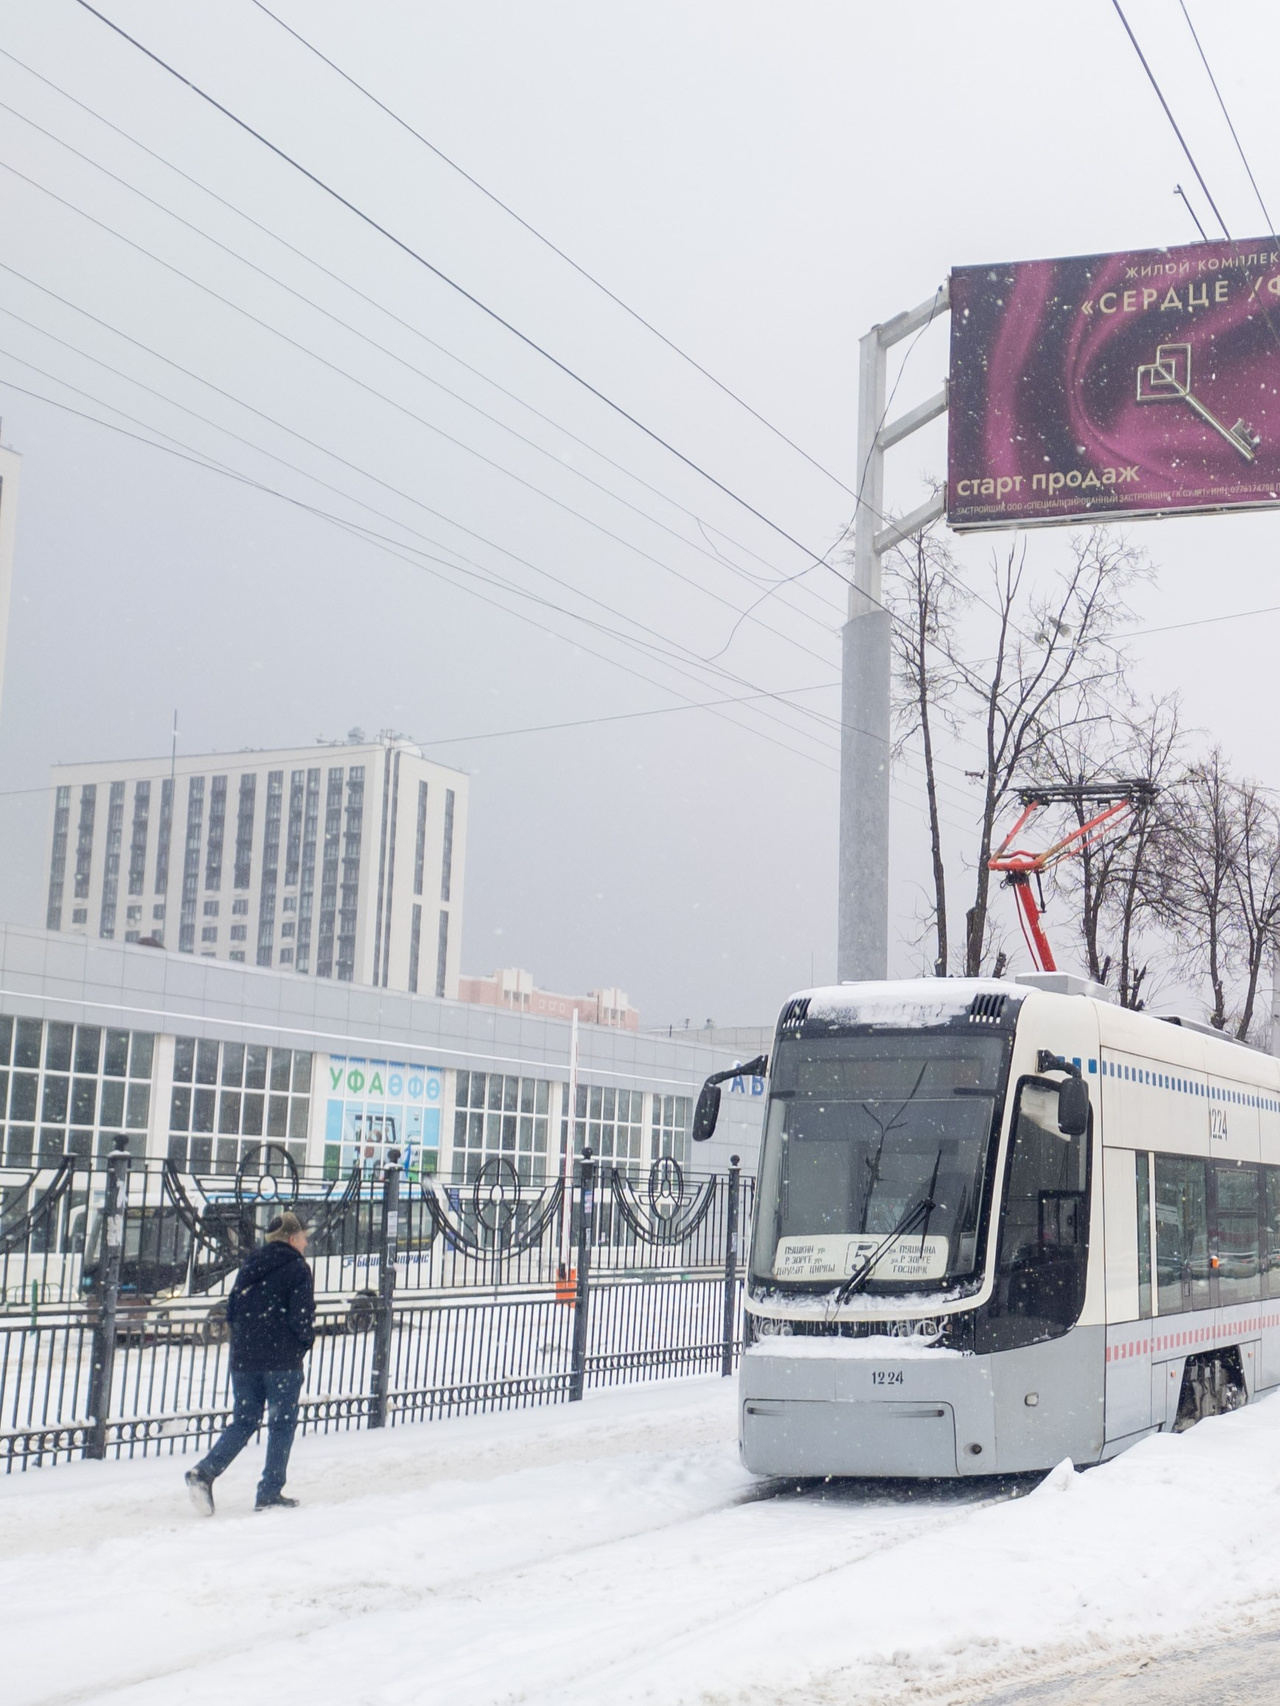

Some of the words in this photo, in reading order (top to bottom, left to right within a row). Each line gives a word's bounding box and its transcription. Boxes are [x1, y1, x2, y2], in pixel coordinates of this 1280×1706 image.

[1125, 260, 1190, 279] ЖИЛОЙ
[1080, 280, 1229, 315] «СЕРДЦЕ
[956, 475, 1023, 499] старт
[1032, 466, 1141, 495] продаж
[956, 502, 1006, 515] ЗАСТРОЙЩИК
[329, 1066, 384, 1096] УФА
[1208, 1107, 1228, 1141] 1224
[784, 1245, 814, 1256] ПУШКИН
[851, 1244, 873, 1273] 5
[892, 1265, 928, 1275] ГОСЦИРК
[871, 1370, 904, 1385] 1224
